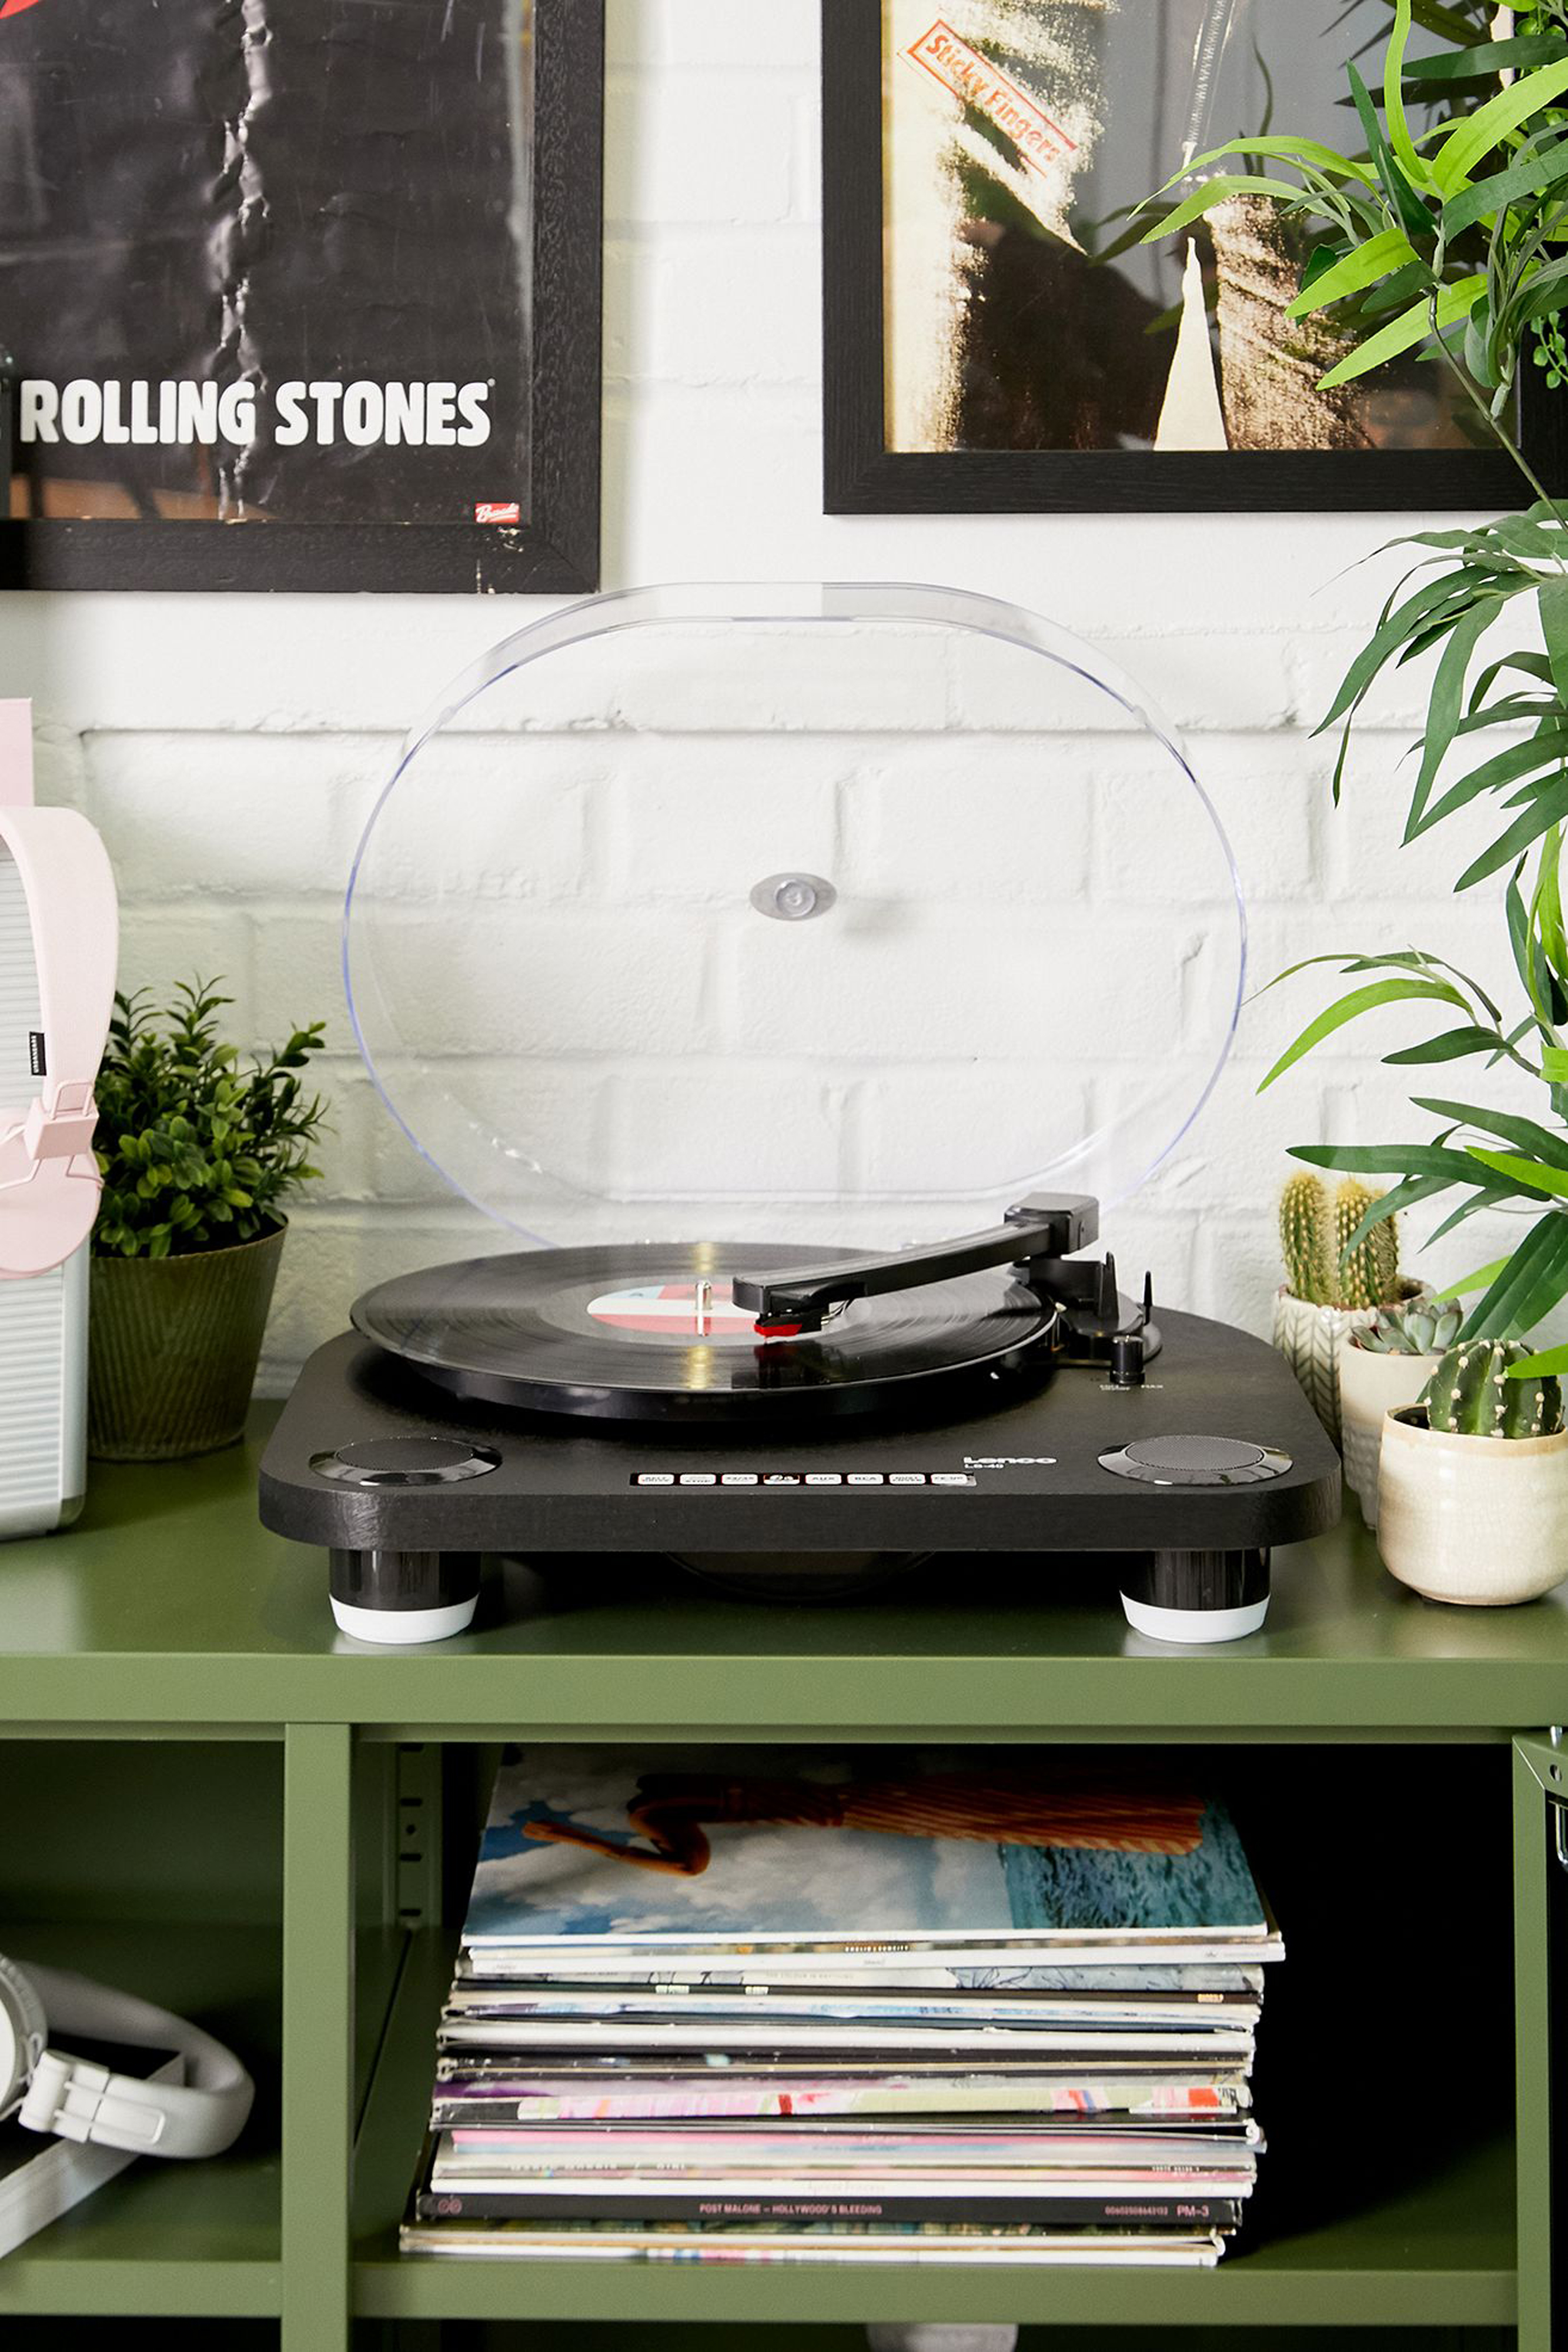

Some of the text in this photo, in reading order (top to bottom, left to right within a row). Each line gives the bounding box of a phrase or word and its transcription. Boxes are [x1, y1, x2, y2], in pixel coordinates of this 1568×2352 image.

[925, 34, 1061, 162] Sticky Fingers
[19, 379, 492, 446] ROLLING STONES
[699, 2204, 722, 2214] POST
[724, 2204, 761, 2214] MALONE
[839, 2204, 882, 2215] BLEEDING
[1176, 2204, 1209, 2217] PM-3
